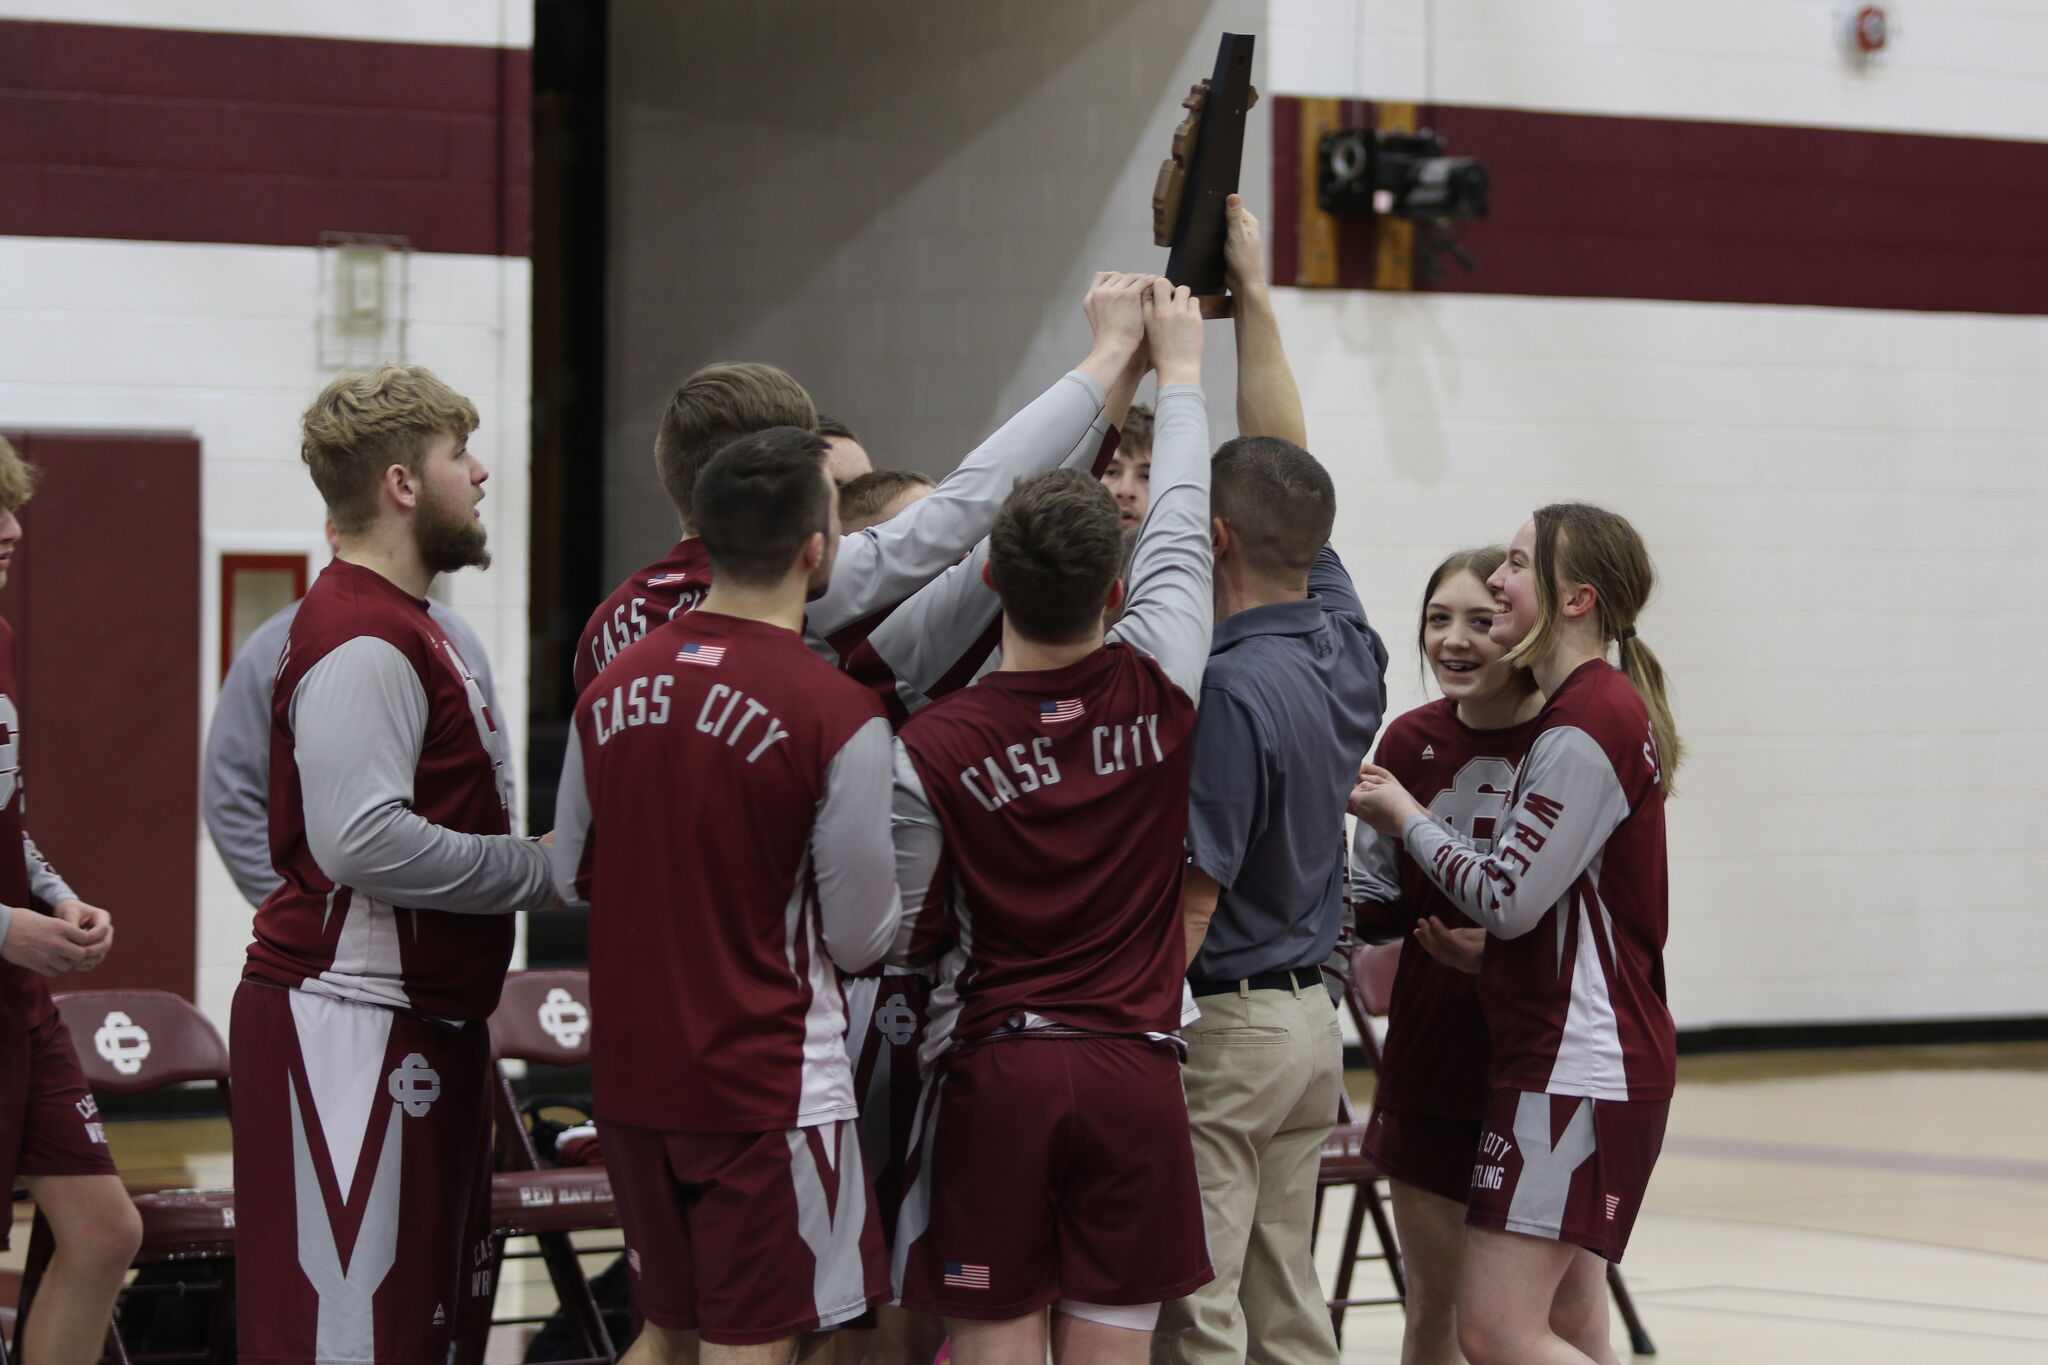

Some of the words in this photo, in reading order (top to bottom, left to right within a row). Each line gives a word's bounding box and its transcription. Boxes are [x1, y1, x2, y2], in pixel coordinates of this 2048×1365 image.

[592, 598, 647, 674] CASS
[592, 674, 674, 745] CASS
[695, 683, 788, 763] CITY
[960, 736, 1061, 811] CASS
[1091, 714, 1162, 775] CITY
[1484, 1132, 1513, 1162] CITY
